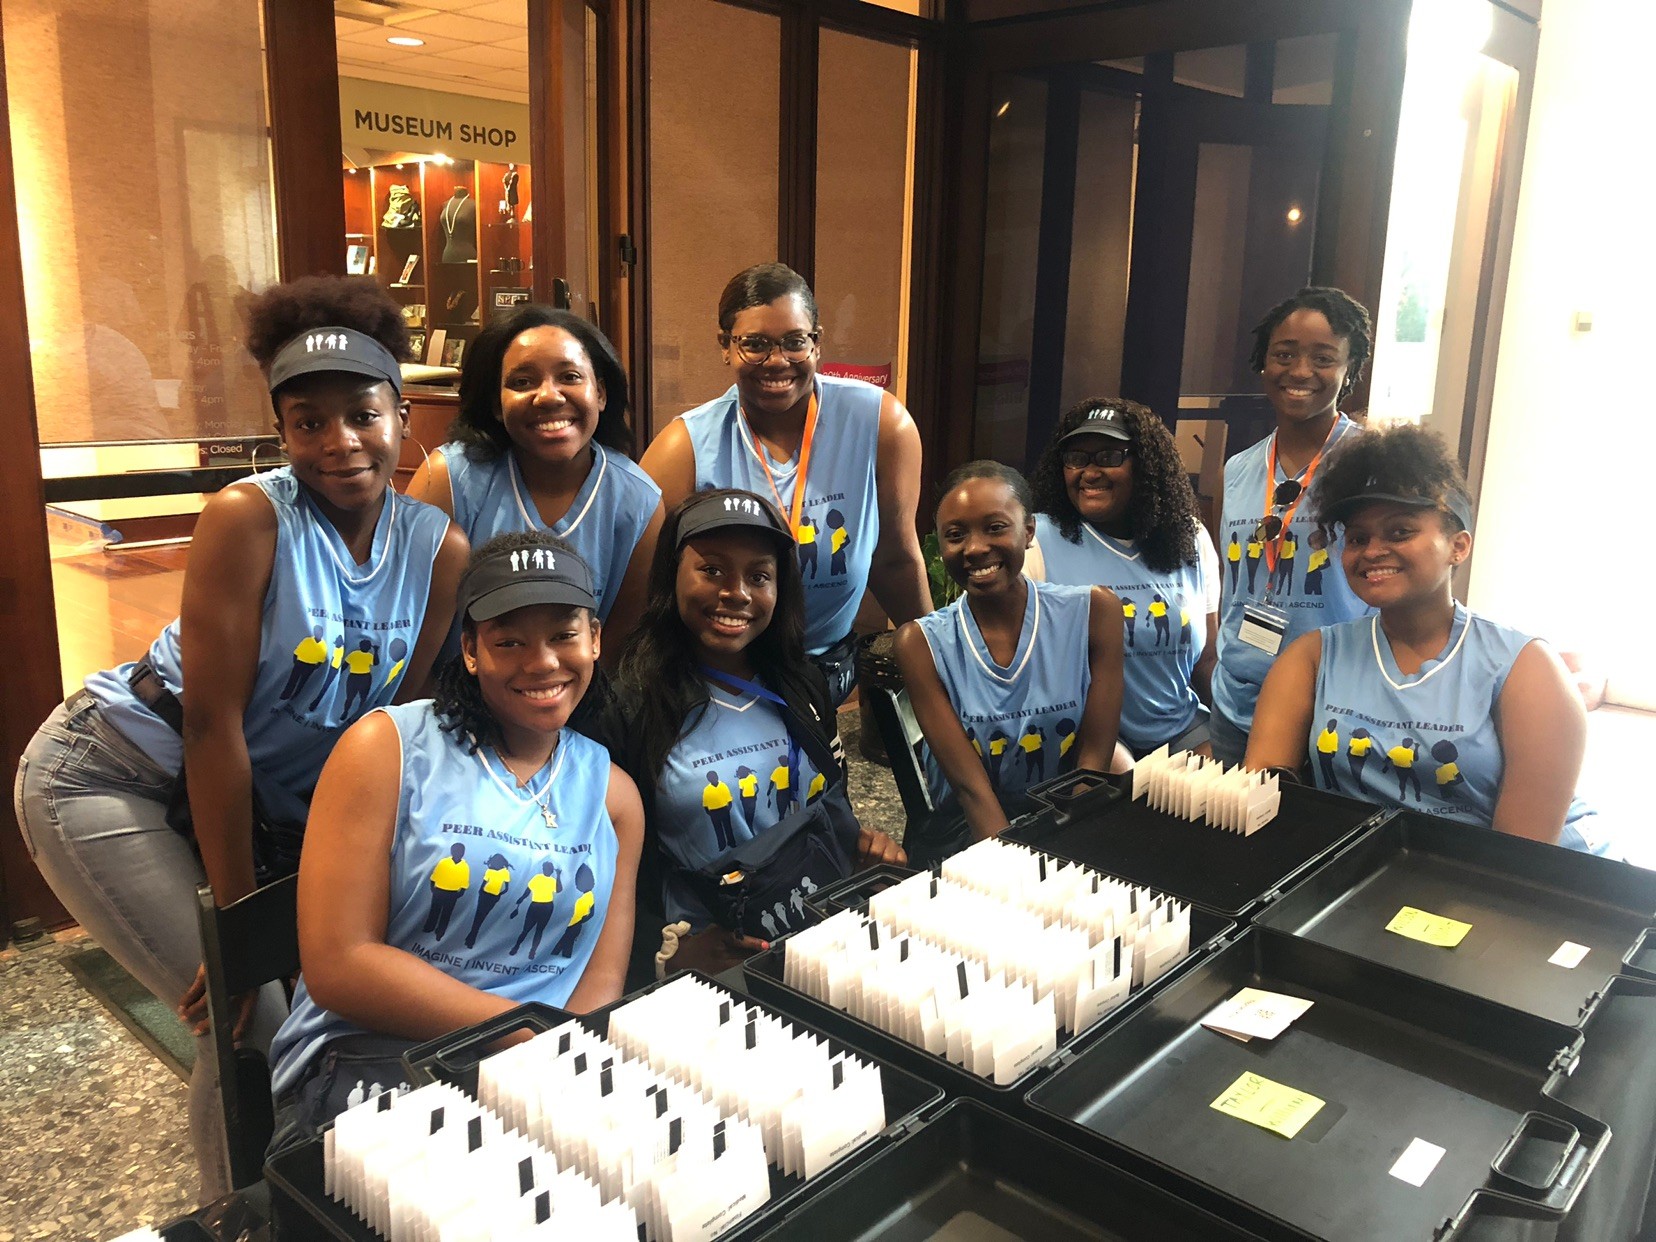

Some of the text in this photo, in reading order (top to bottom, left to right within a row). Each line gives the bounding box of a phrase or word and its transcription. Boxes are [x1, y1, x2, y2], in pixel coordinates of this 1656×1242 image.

[354, 109, 517, 147] MUSEUM SHOP
[201, 396, 223, 405] 4pm
[210, 444, 243, 454] Closed
[809, 492, 845, 507] LEADER
[1115, 583, 1153, 591] ASSISTAN
[1035, 700, 1077, 715] LEADER
[1325, 704, 1464, 732] PEER ASSISTANT LEADER
[692, 752, 726, 769] PEER
[726, 739, 781, 758] ASSISTANT
[442, 823, 483, 837] PEER
[486, 829, 551, 851] ASSISTANT
[411, 942, 463, 967] IMAGINE
[471, 960, 520, 976] INVENT
